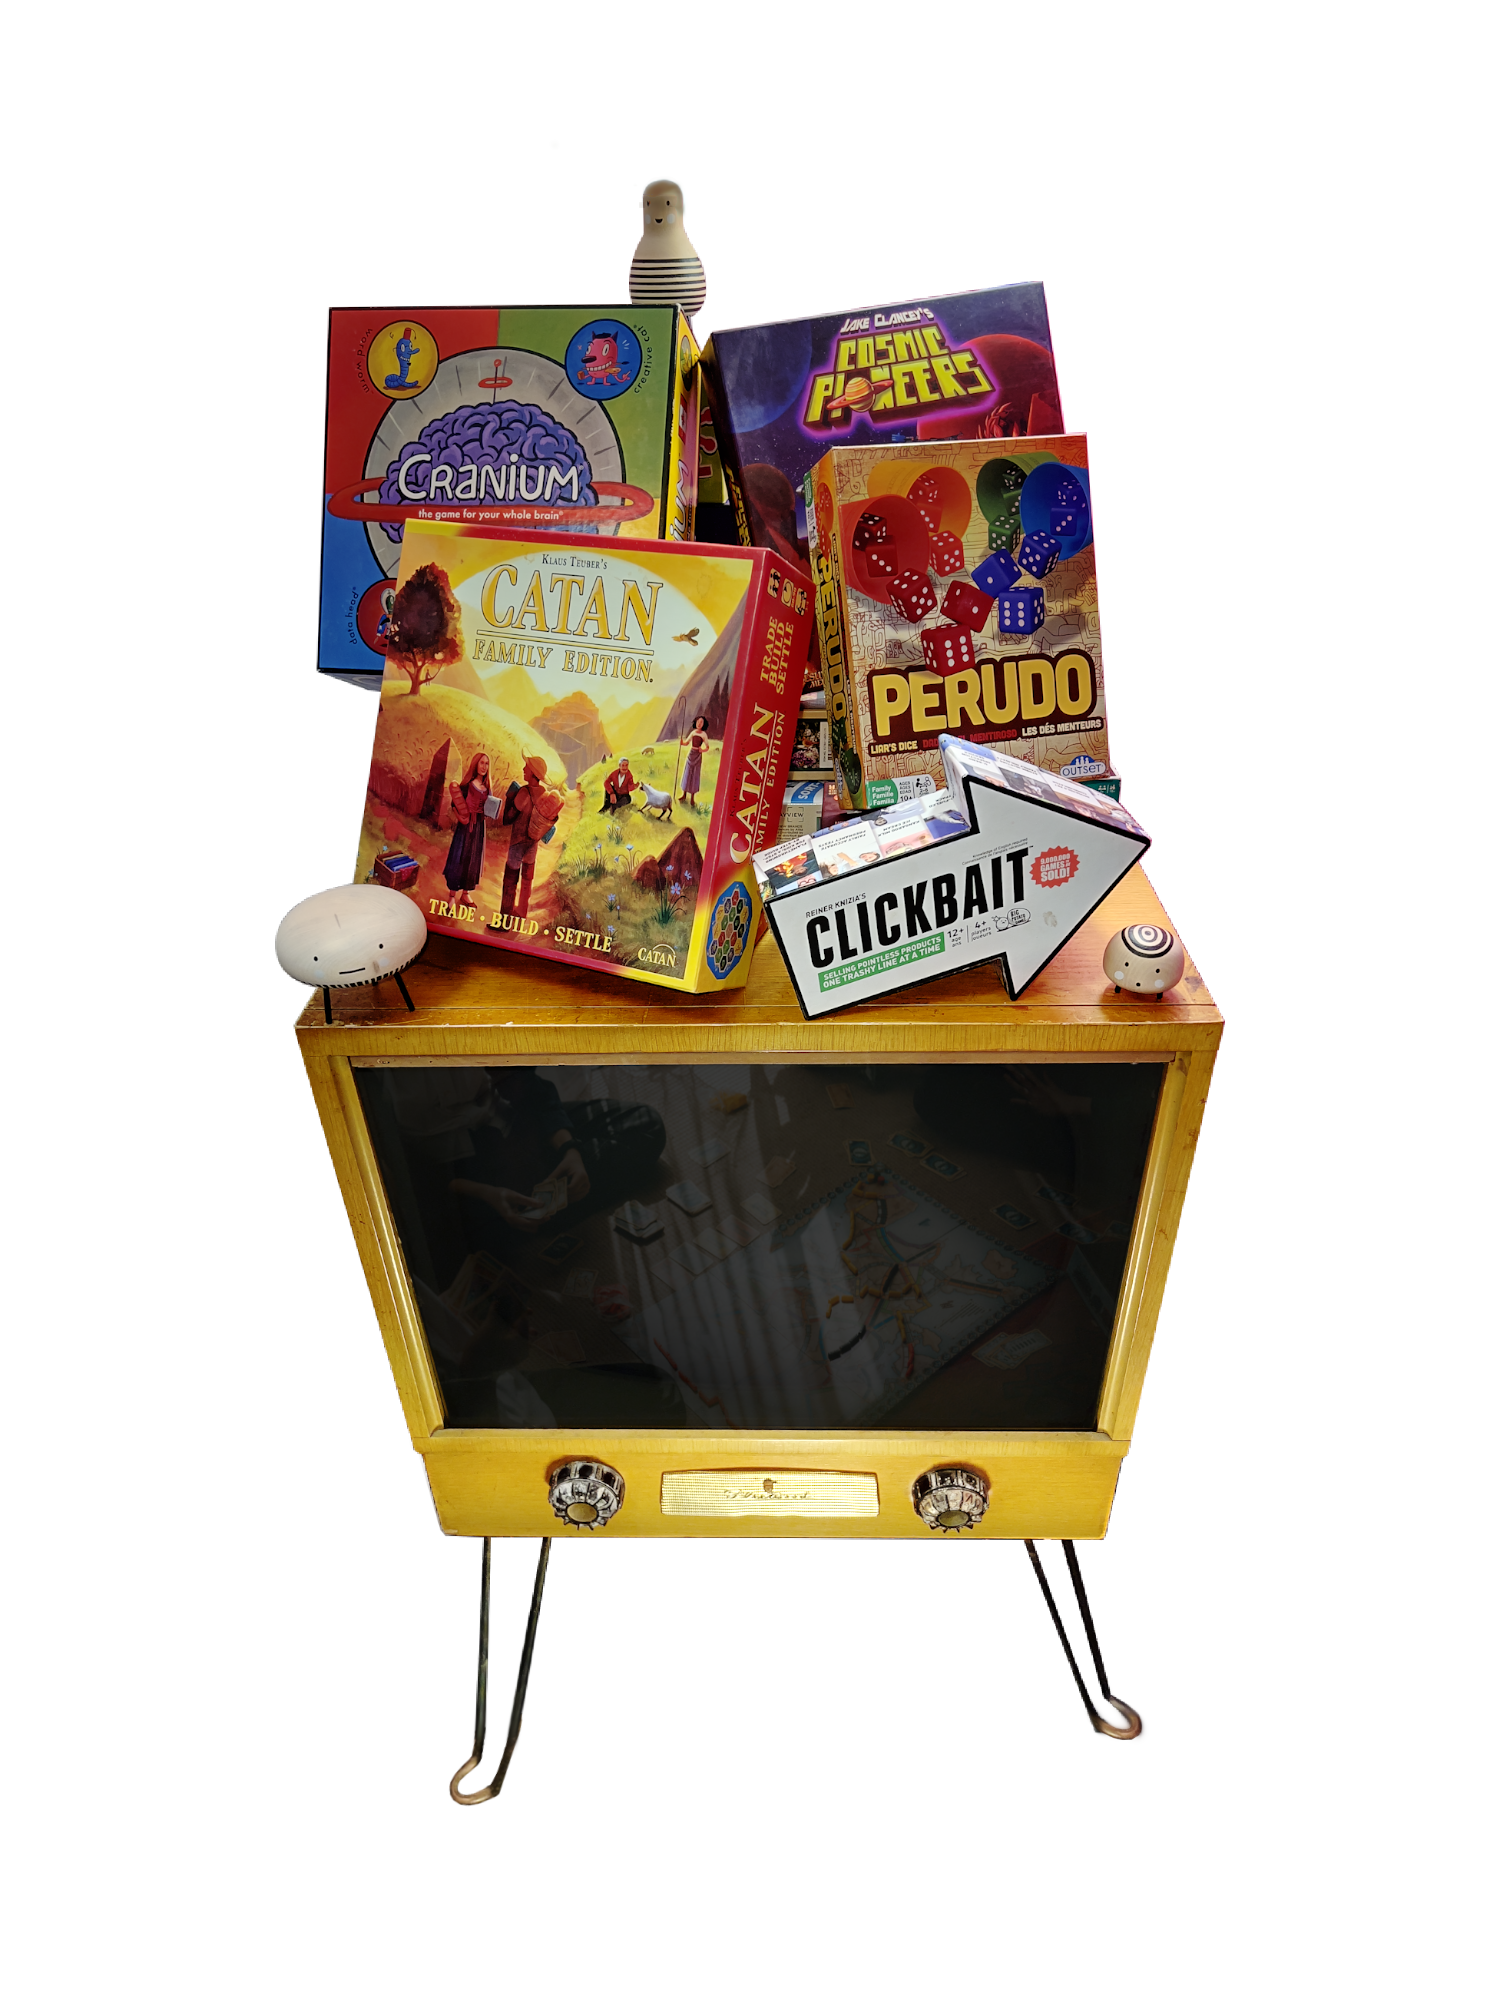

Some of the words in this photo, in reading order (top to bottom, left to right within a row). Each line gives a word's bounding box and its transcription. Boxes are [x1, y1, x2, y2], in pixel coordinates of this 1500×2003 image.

[637, 325, 650, 343] cat
[840, 318, 870, 333] JAKE
[874, 308, 934, 328] CLANCEY'S
[357, 328, 373, 358] word
[836, 325, 950, 372] COSMIC
[356, 361, 370, 394] worm
[634, 347, 653, 394] creative
[805, 351, 996, 423] PINEERS
[418, 509, 433, 519] the
[434, 511, 461, 521] game
[462, 510, 477, 519] for
[478, 511, 501, 522] your
[502, 510, 532, 520] whole
[533, 510, 560, 520] brain
[541, 554, 567, 566] KLAUS
[569, 556, 608, 570] TEUBER'S
[345, 590, 359, 618] head
[480, 563, 664, 646] CATAN
[348, 620, 359, 646] data
[760, 616, 778, 682] TRADE
[818, 556, 847, 720] PERUDO
[472, 638, 553, 669] FAMILY
[562, 650, 653, 682] EDITION
[768, 622, 784, 687] BUILD
[775, 622, 794, 695] SETTLE
[872, 653, 1092, 737] PERUDO
[870, 743, 897, 755] LIAR'S
[898, 740, 918, 751] DICE
[970, 729, 1018, 743] MENTIROSO
[1021, 727, 1037, 737] LES
[1039, 723, 1055, 734] DÉS
[1056, 718, 1102, 732] MENTEURS
[729, 702, 775, 864] CATAN
[753, 797, 771, 855] AMILY
[766, 711, 786, 788] EDITION
[1062, 763, 1102, 777] OUTSET
[871, 785, 892, 793] Family
[873, 798, 895, 806] Familia
[1040, 861, 1065, 872] GAMES
[1040, 867, 1070, 882] SOLD!
[805, 904, 834, 919] REINER
[834, 892, 867, 909] KNIZIA'S
[806, 847, 1029, 969] CLICKBAIT
[429, 899, 476, 923] TRADE
[490, 912, 539, 936] BUILD
[554, 926, 613, 953] SETTLE
[947, 928, 964, 938] 12+
[637, 947, 677, 968] CATAN
[822, 978, 842, 989] ONE
[842, 966, 876, 983] TRASHY
[878, 958, 898, 971] LINE
[898, 954, 910, 964] AT
[919, 943, 941, 957] TIME
[823, 964, 857, 981] SELLING
[857, 950, 900, 970] POINTLESS
[900, 936, 942, 956] PRODUCTS
